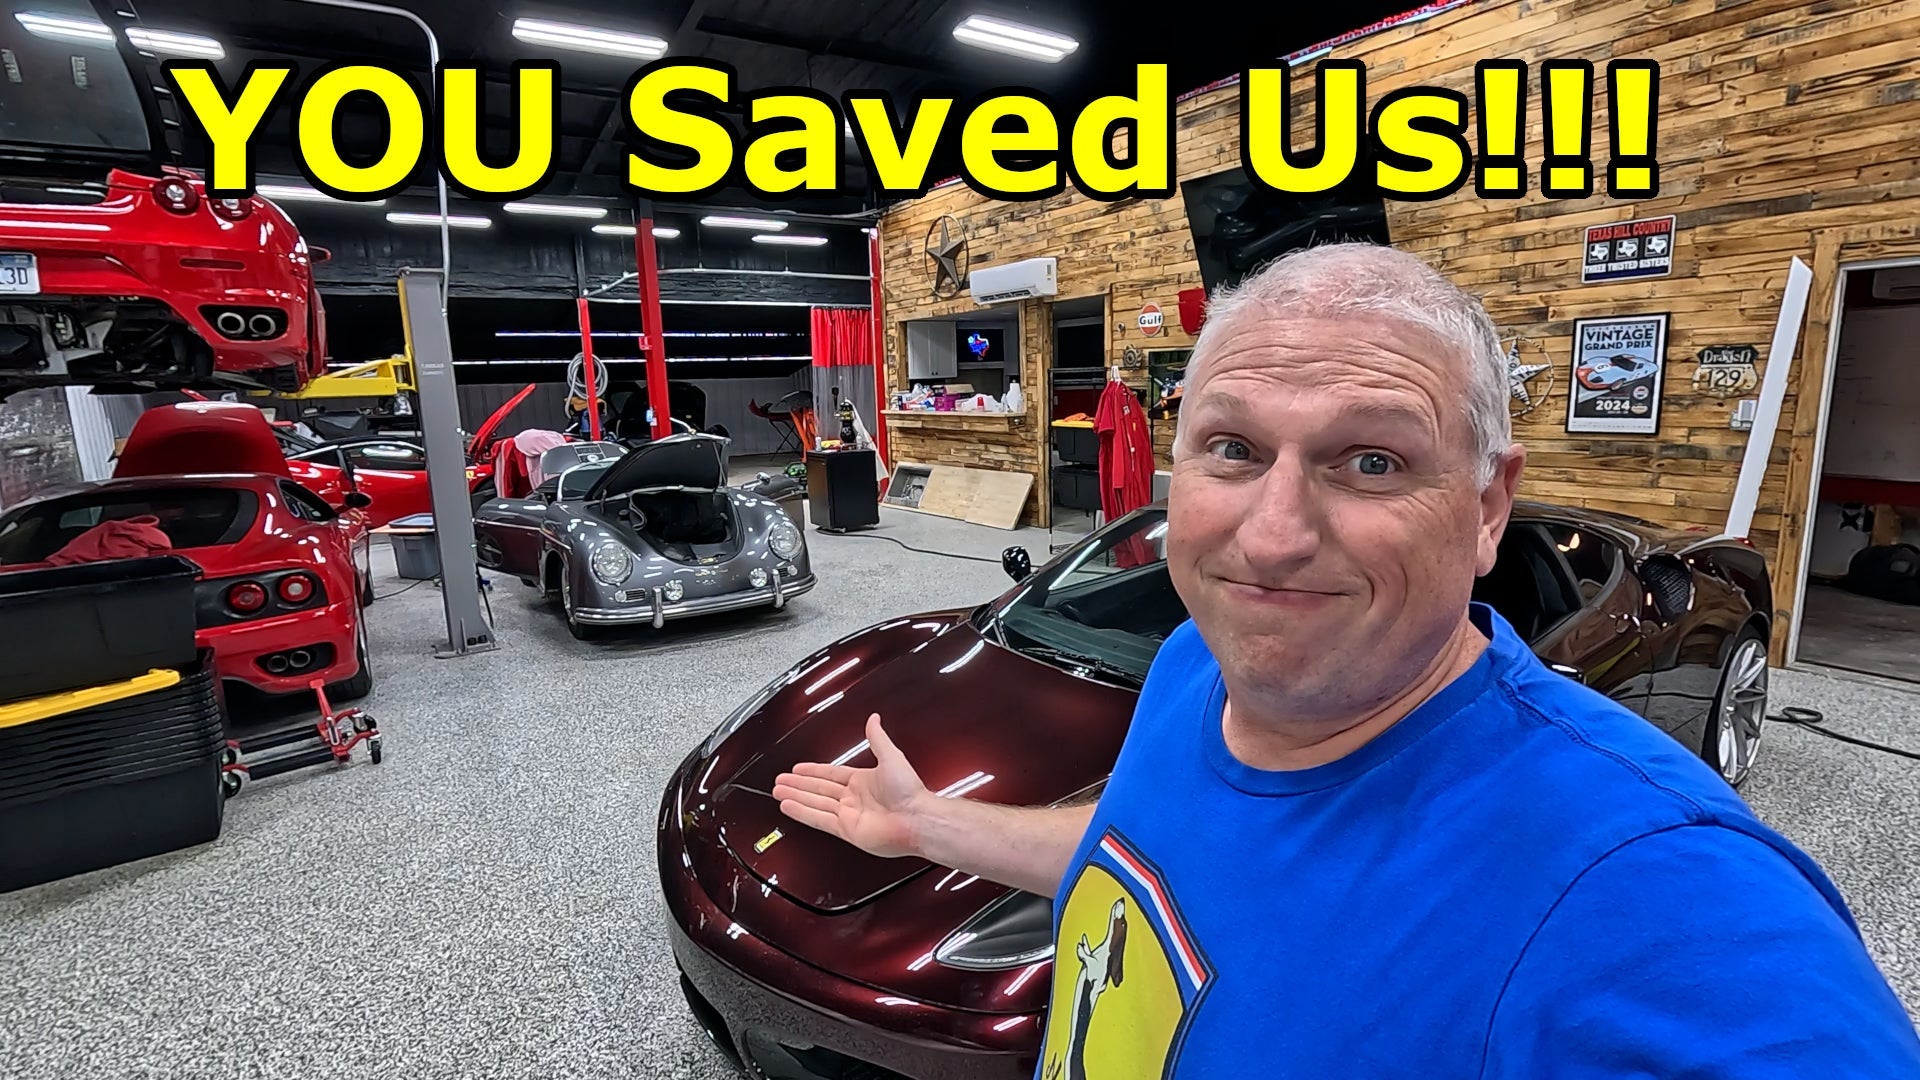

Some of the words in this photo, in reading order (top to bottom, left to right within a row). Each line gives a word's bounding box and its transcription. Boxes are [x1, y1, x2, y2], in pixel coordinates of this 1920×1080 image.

[1589, 227, 1612, 241] TEXAS
[1613, 224, 1631, 238] HILL
[1632, 220, 1671, 236] COUNTRY
[0, 266, 28, 285] 3D
[1140, 315, 1162, 325] Gulf
[1586, 328, 1654, 342] VINTAGE
[1585, 342, 1623, 351] GRAND
[1626, 340, 1652, 349] PRIX
[1708, 369, 1742, 389] 129
[1595, 400, 1630, 411] 2024
